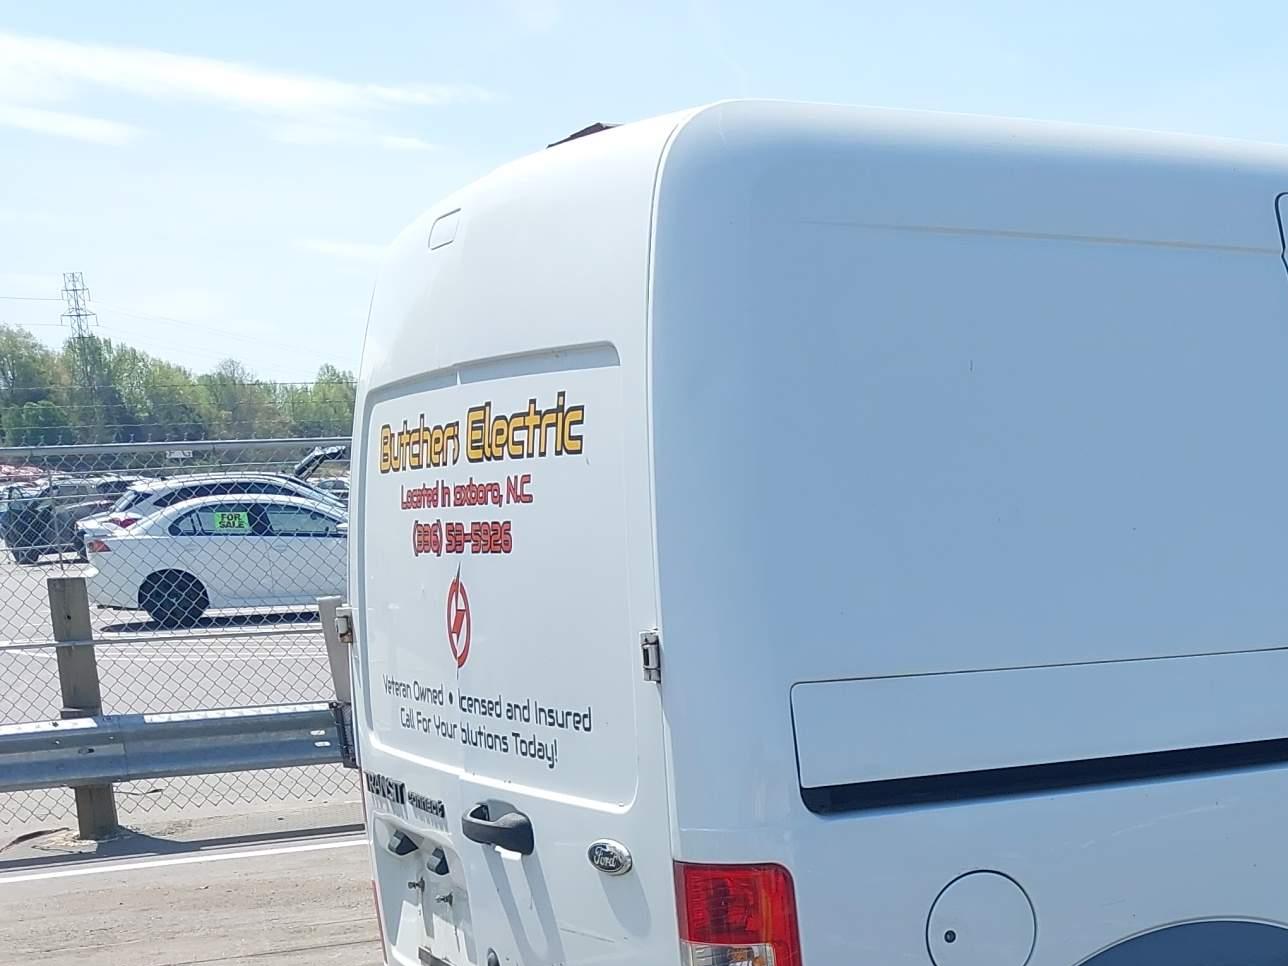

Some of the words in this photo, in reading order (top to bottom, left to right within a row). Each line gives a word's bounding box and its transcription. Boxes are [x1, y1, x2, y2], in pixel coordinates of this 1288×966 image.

[466, 391, 584, 462] Electric
[401, 480, 439, 510] Located
[219, 520, 245, 528] SALE
[221, 513, 241, 521] FOR
[412, 519, 443, 557] (336)
[382, 674, 412, 699] Veteran
[413, 681, 444, 706] Owned
[506, 699, 531, 723] and
[534, 701, 592, 732] Insured
[400, 707, 415, 730] Call
[416, 711, 431, 734] For
[433, 715, 458, 739] Your
[512, 731, 558, 769] Today!
